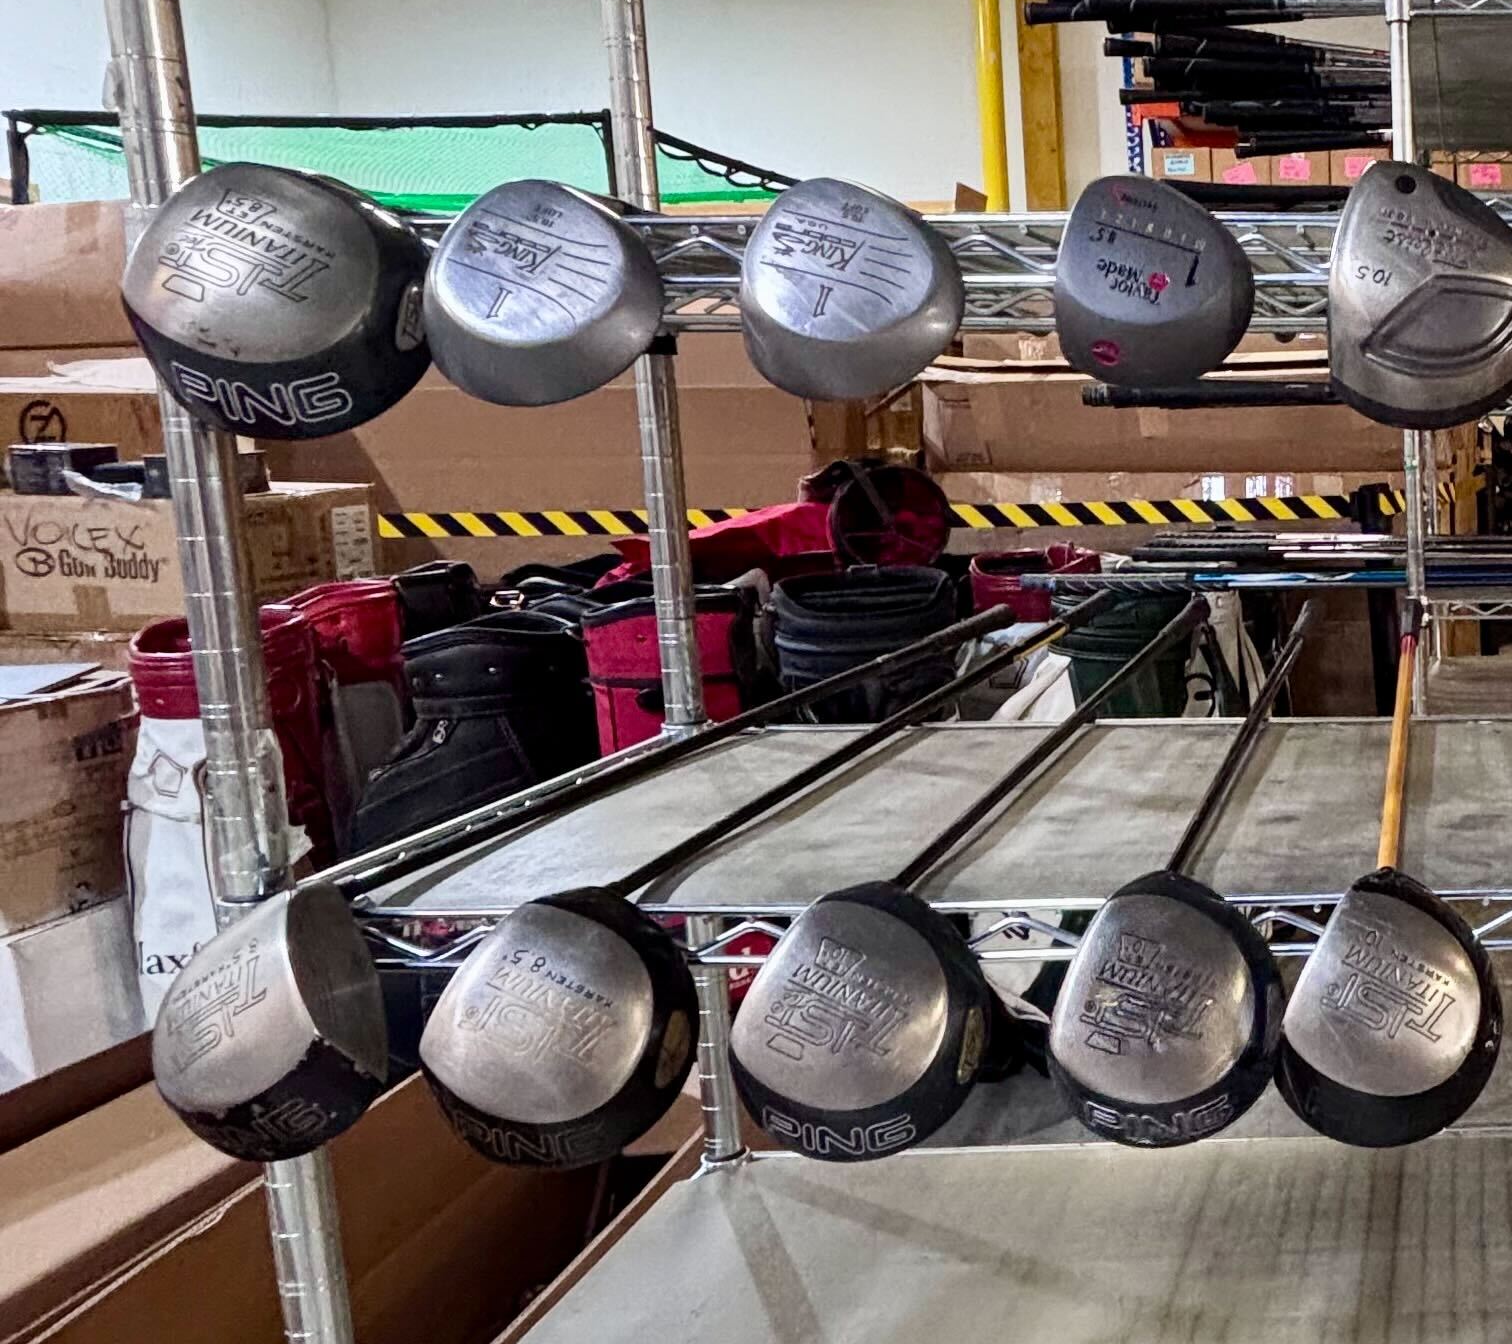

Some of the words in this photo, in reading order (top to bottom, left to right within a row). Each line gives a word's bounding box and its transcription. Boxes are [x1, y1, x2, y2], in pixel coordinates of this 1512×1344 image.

[260, 221, 336, 258] KARSTEN
[796, 218, 828, 230] USA
[1095, 258, 1142, 284] Made
[1184, 255, 1200, 288] 1
[1355, 266, 1392, 287] 10.5
[488, 287, 513, 320] 1
[1108, 275, 1162, 306] Taylor
[171, 361, 352, 425] PING
[1389, 949, 1451, 986] KARSTEN
[546, 969, 613, 1008] KARSTEN
[762, 1105, 916, 1156] PING
[1084, 1093, 1234, 1141] PING
